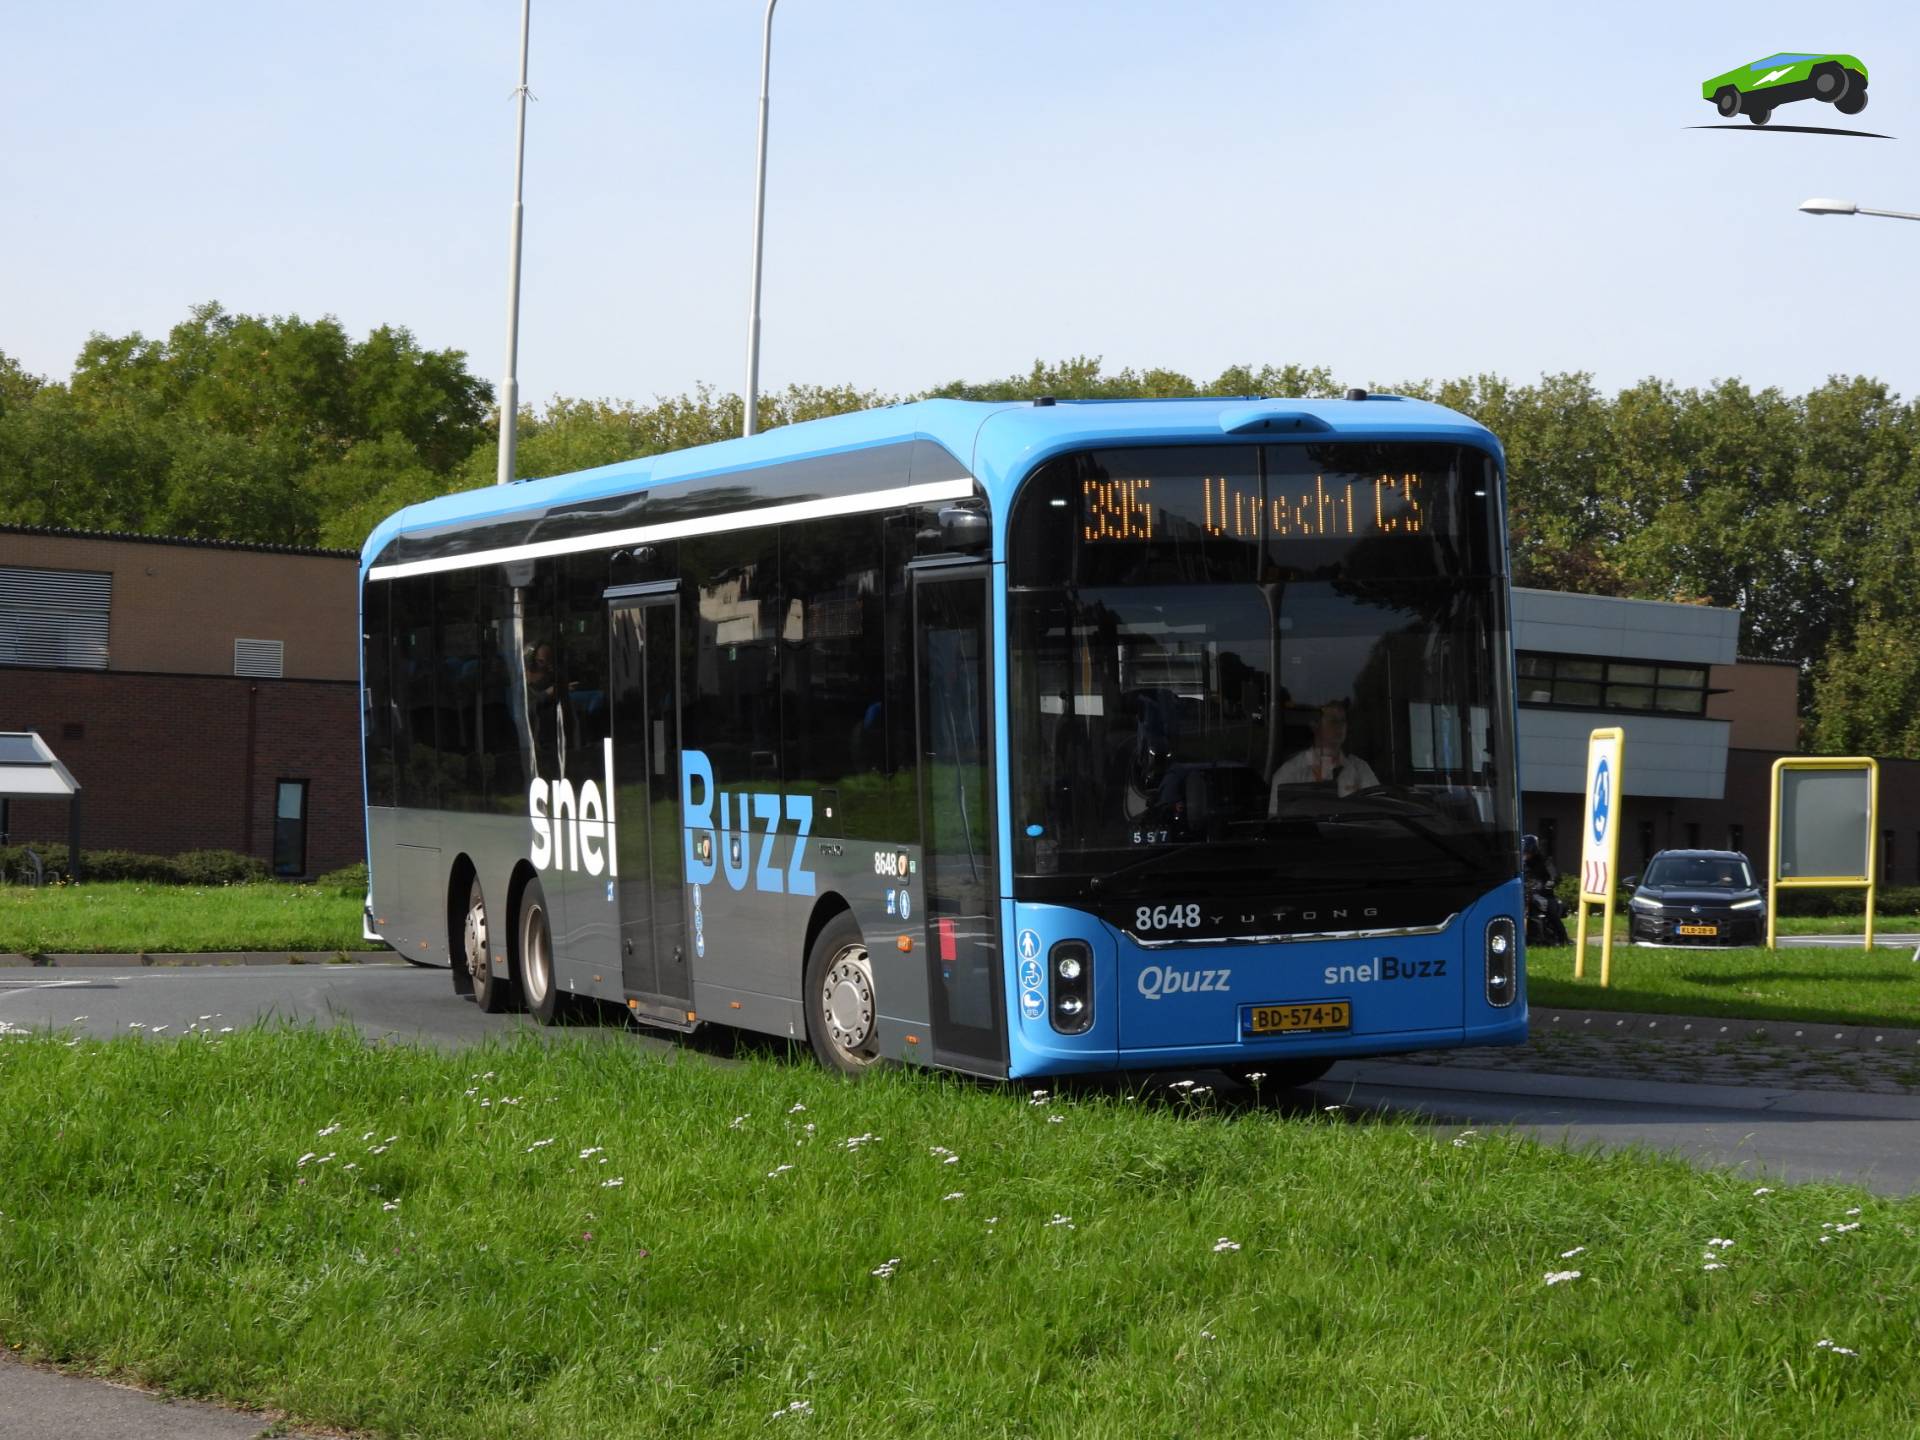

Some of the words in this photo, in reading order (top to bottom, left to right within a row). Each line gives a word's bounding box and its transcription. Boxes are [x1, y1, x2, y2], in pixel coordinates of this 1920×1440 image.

[1083, 479, 1150, 540] 395
[1375, 473, 1423, 533] CS
[529, 737, 618, 877] snel
[874, 851, 897, 876] 8648
[1135, 904, 1201, 931] 8648
[1210, 907, 1379, 925] YUTONG
[1137, 966, 1232, 1000] Qbuzz
[1258, 1006, 1344, 1028] BD-574-D
